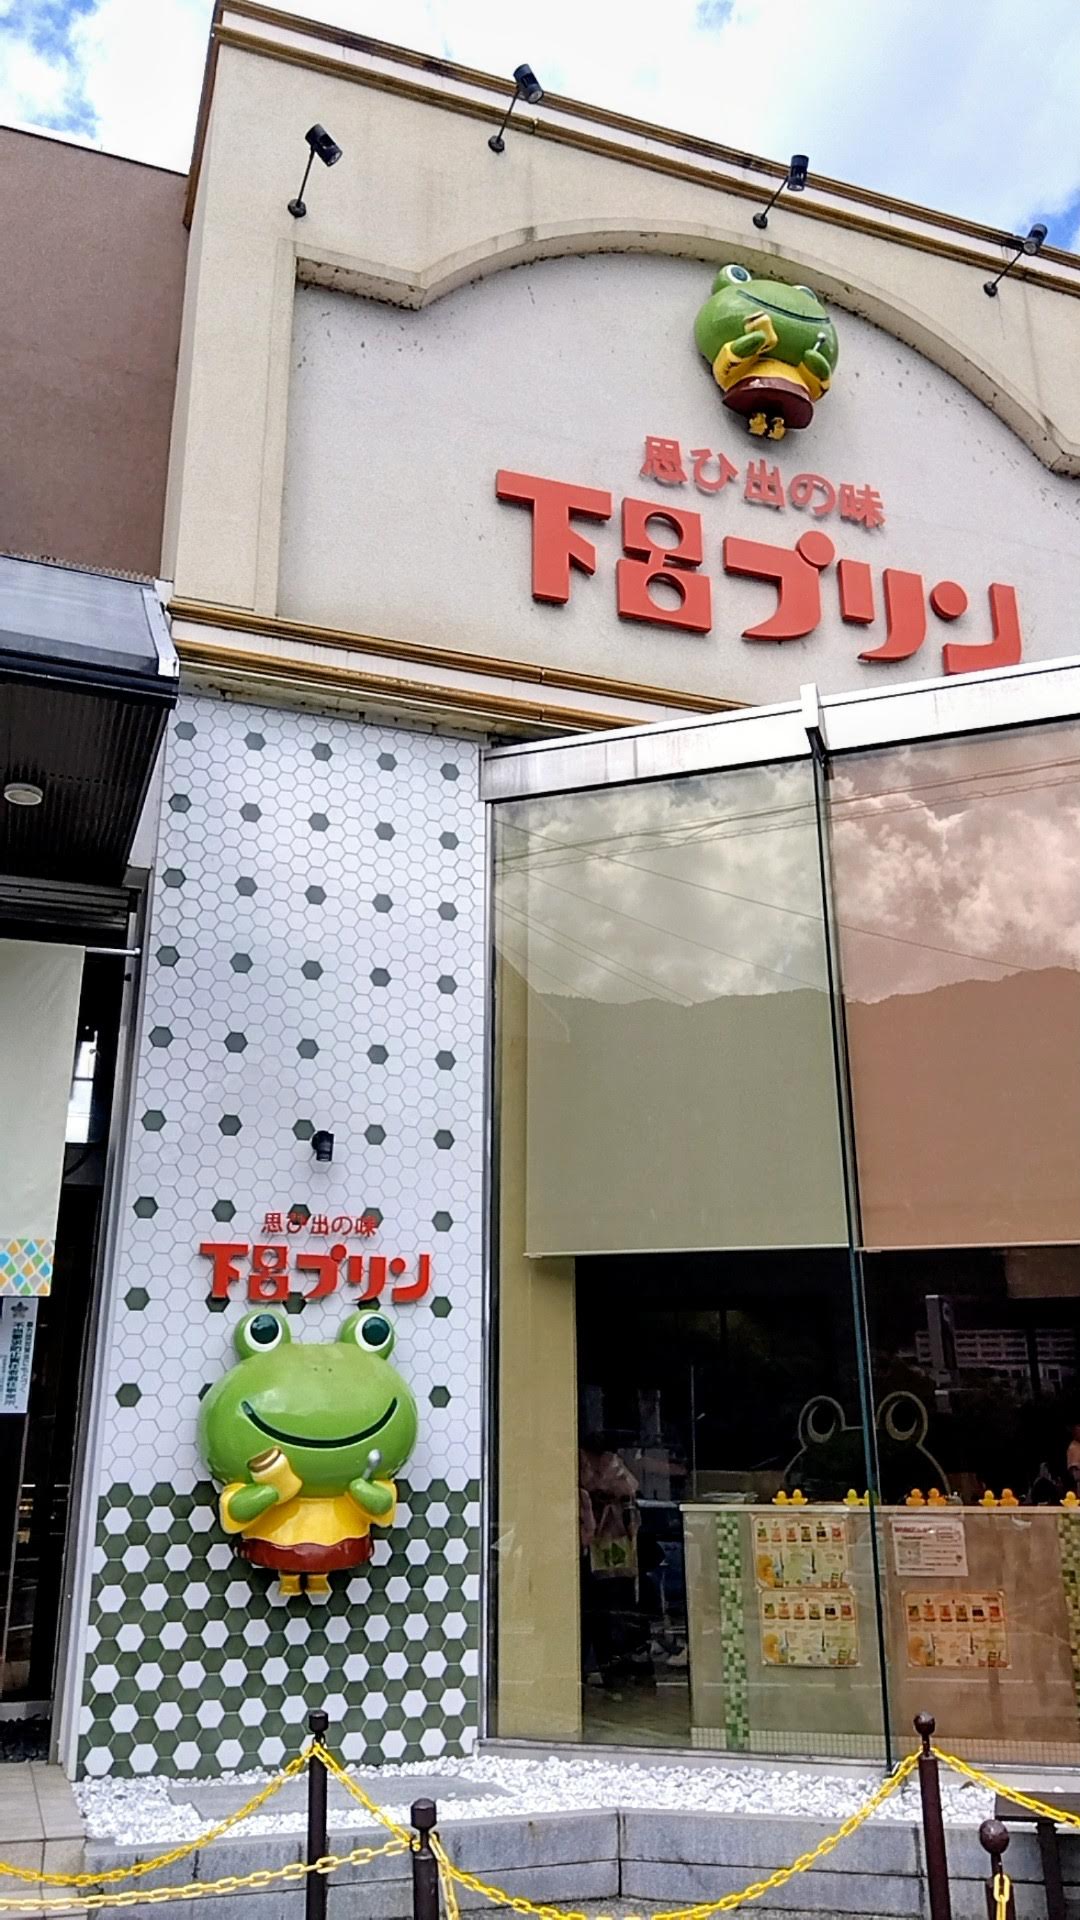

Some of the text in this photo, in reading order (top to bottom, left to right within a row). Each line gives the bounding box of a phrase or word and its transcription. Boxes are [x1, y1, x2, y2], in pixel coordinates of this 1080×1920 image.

[640, 435, 886, 529] 思ひ出の味
[495, 468, 1024, 676] 下呂プリン
[262, 1211, 378, 1238] 思ひ出の味
[199, 1242, 432, 1303] 下呂プリン
